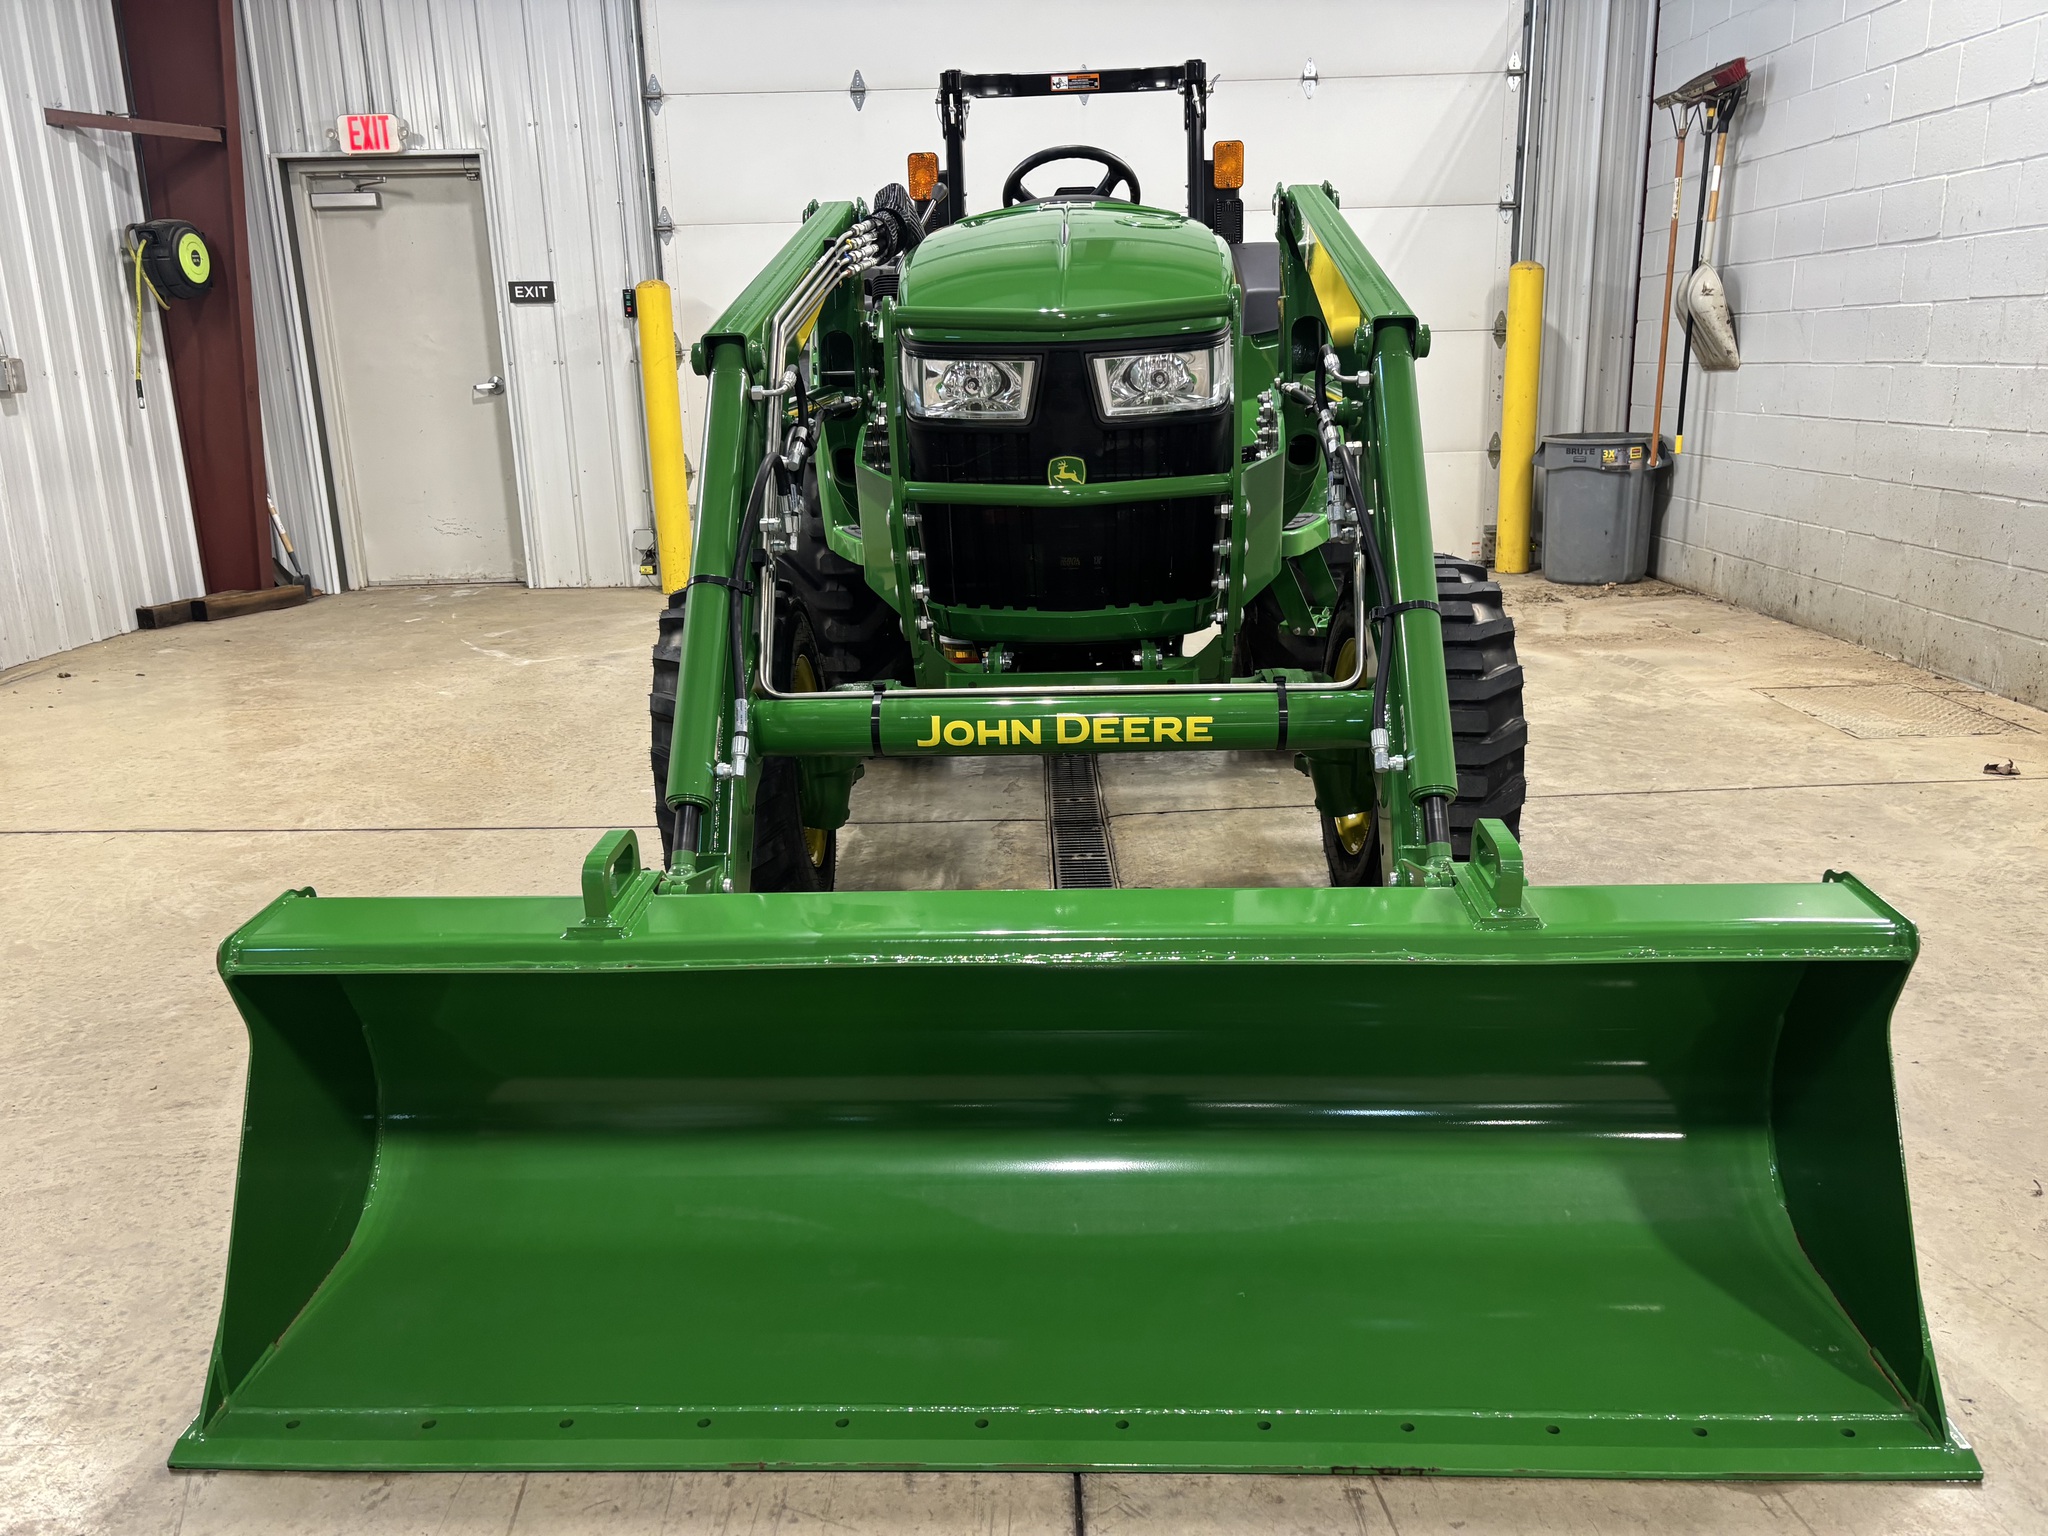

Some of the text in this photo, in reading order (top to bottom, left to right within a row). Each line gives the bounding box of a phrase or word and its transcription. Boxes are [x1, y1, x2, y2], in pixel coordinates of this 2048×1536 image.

[346, 115, 390, 151] EXIT
[514, 285, 549, 298] EXIT
[1565, 447, 1596, 455] BRUTE
[1602, 449, 1616, 458] 3X
[917, 713, 1213, 747] JOHN DEERE
